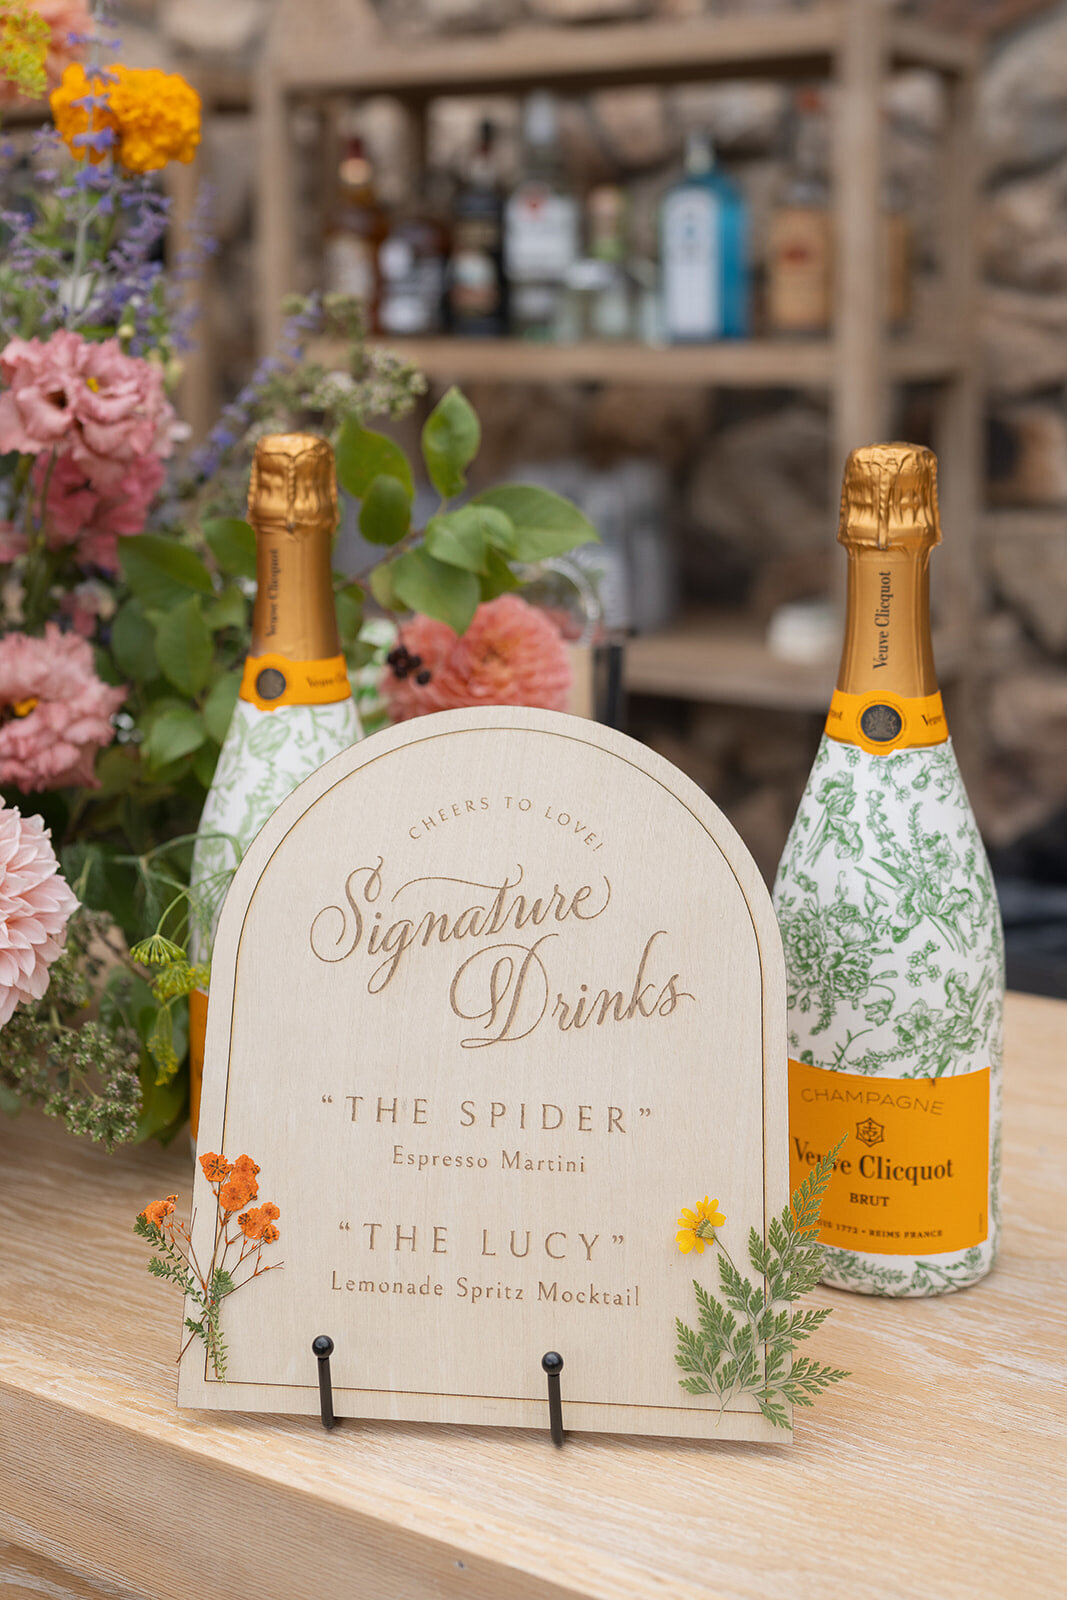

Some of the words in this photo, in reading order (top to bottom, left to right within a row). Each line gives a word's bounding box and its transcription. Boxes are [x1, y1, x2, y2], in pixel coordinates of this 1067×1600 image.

[874, 570, 894, 628] Clicquot
[872, 630, 889, 671] Veuve
[408, 796, 490, 840] CHEERS
[504, 796, 532, 812] TO
[544, 805, 604, 852] LOVE!
[309, 855, 612, 995] Signature
[449, 931, 696, 1049] Drinks
[800, 1088, 945, 1116] CHAMPAGNE
[392, 1144, 489, 1172] Espresso
[501, 1149, 586, 1173] Martini
[859, 1154, 954, 1186] Clicquot
[849, 1192, 890, 1208] BRUT
[904, 1229, 943, 1239] FRANCE
[331, 1270, 444, 1297] Lemonade
[456, 1276, 524, 1304] Spritz
[537, 1280, 640, 1307] Mocktail
